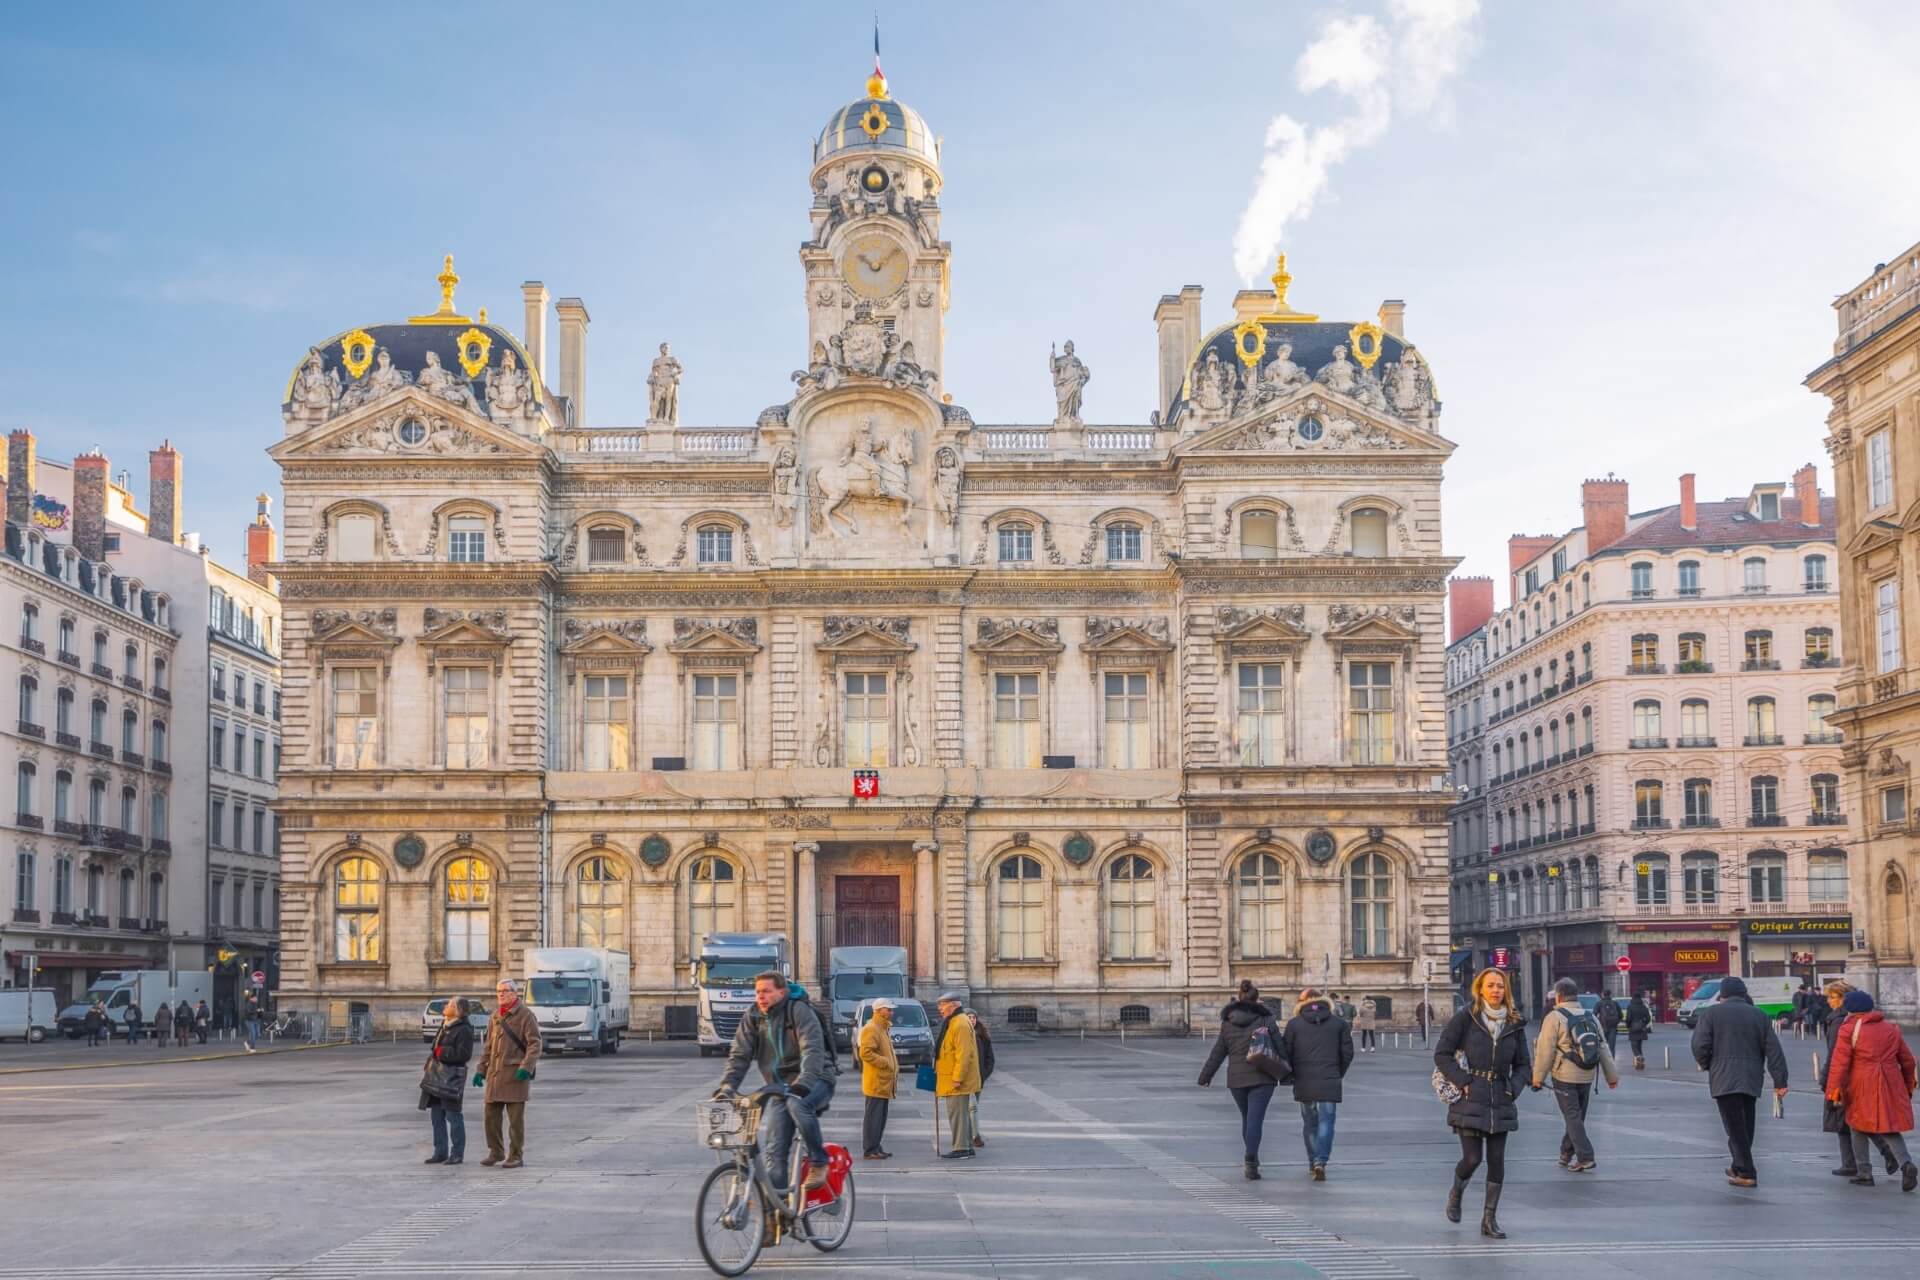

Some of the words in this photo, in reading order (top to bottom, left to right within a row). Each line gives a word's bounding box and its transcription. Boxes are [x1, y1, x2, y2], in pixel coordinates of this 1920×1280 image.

[1751, 921, 1794, 933] Optique
[1798, 919, 1849, 930] Terreaux
[1677, 952, 1716, 960] NICOLAS
